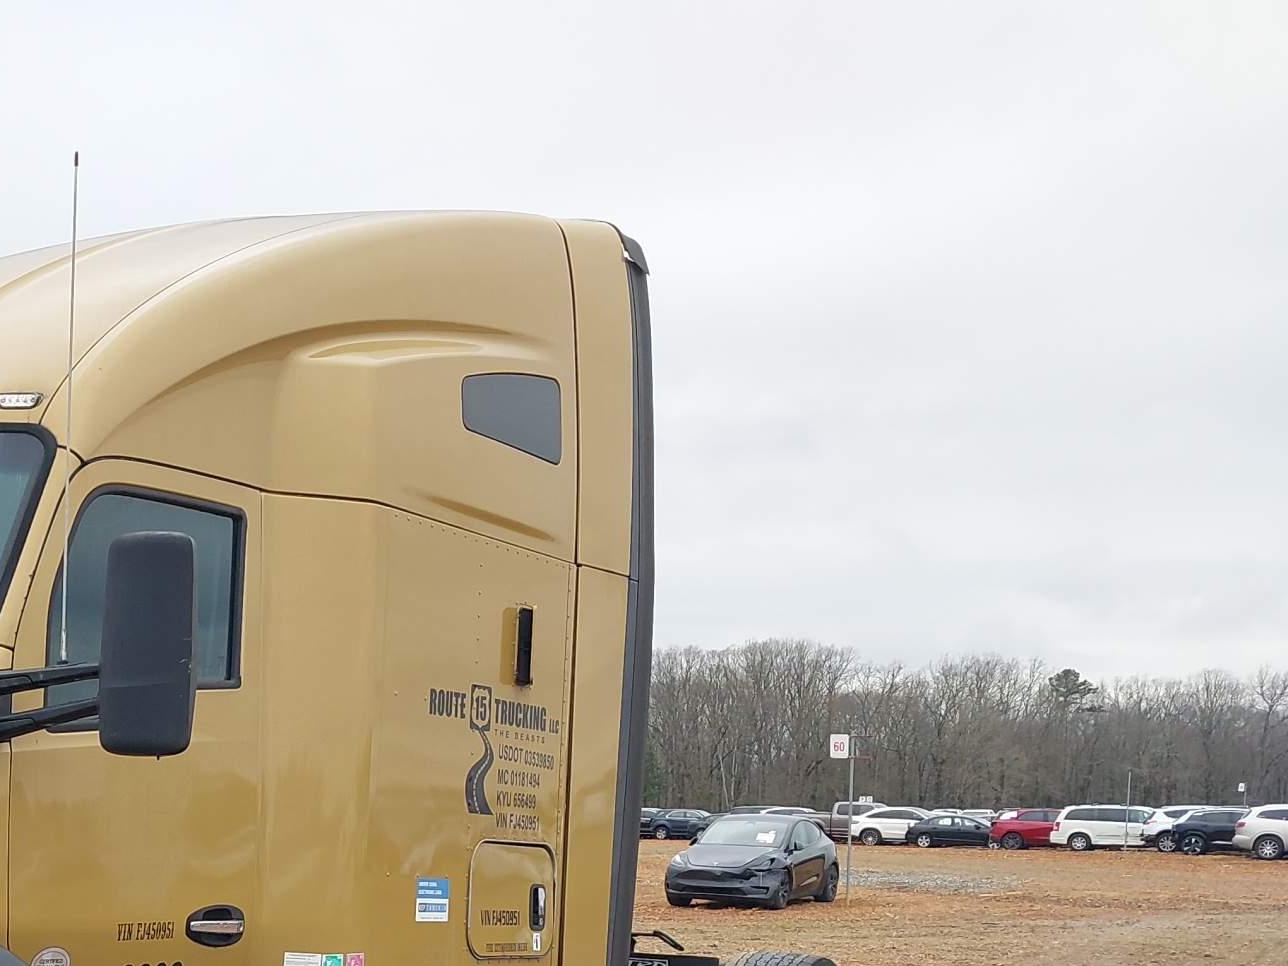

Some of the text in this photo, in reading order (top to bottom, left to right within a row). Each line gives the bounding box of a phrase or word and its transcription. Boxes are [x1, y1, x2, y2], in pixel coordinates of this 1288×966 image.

[429, 688, 560, 734] ROUTE 15 TRUCKING LLC
[494, 729, 510, 739] THE
[498, 743, 524, 765] USDOT
[833, 741, 845, 752] 60
[497, 769, 509, 785] MC
[496, 790, 512, 808] KYU
[495, 812, 540, 831] VIN FJ450951
[480, 909, 521, 926] VIN FJ450951
[117, 921, 175, 941] VIN FJ450951
